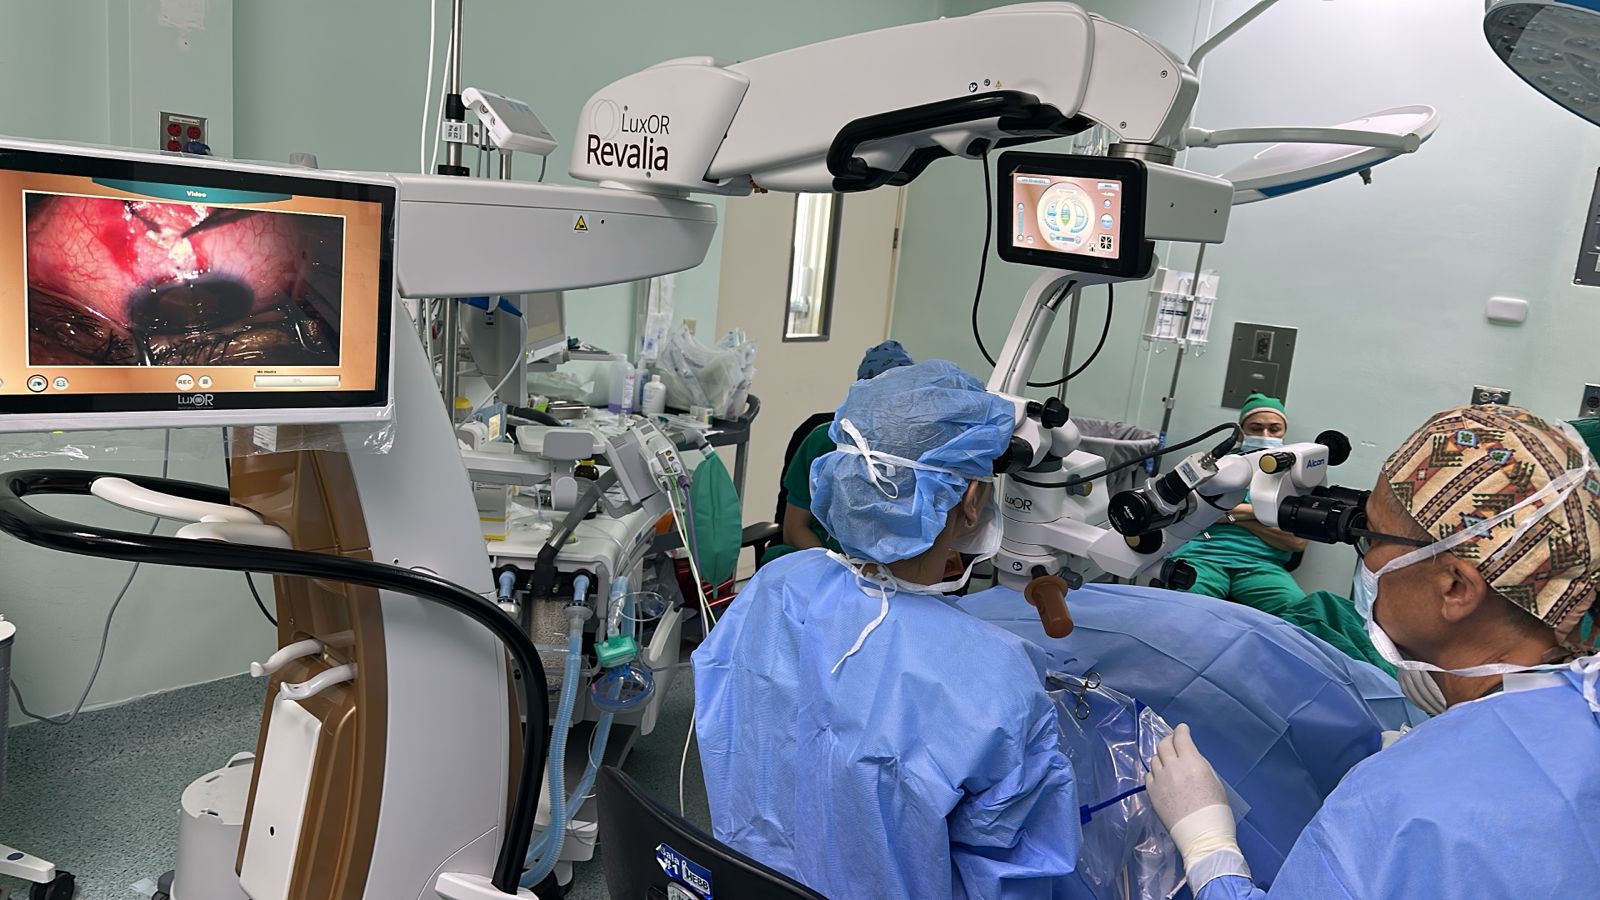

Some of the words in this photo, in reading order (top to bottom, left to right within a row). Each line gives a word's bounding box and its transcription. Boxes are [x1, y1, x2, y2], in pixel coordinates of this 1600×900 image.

[621, 113, 670, 134] LuxOR
[586, 133, 669, 171] Revalia
[186, 190, 207, 198] Video
[177, 394, 214, 406] LuxOR
[1306, 458, 1325, 469] Alcon
[660, 847, 680, 866] Sala
